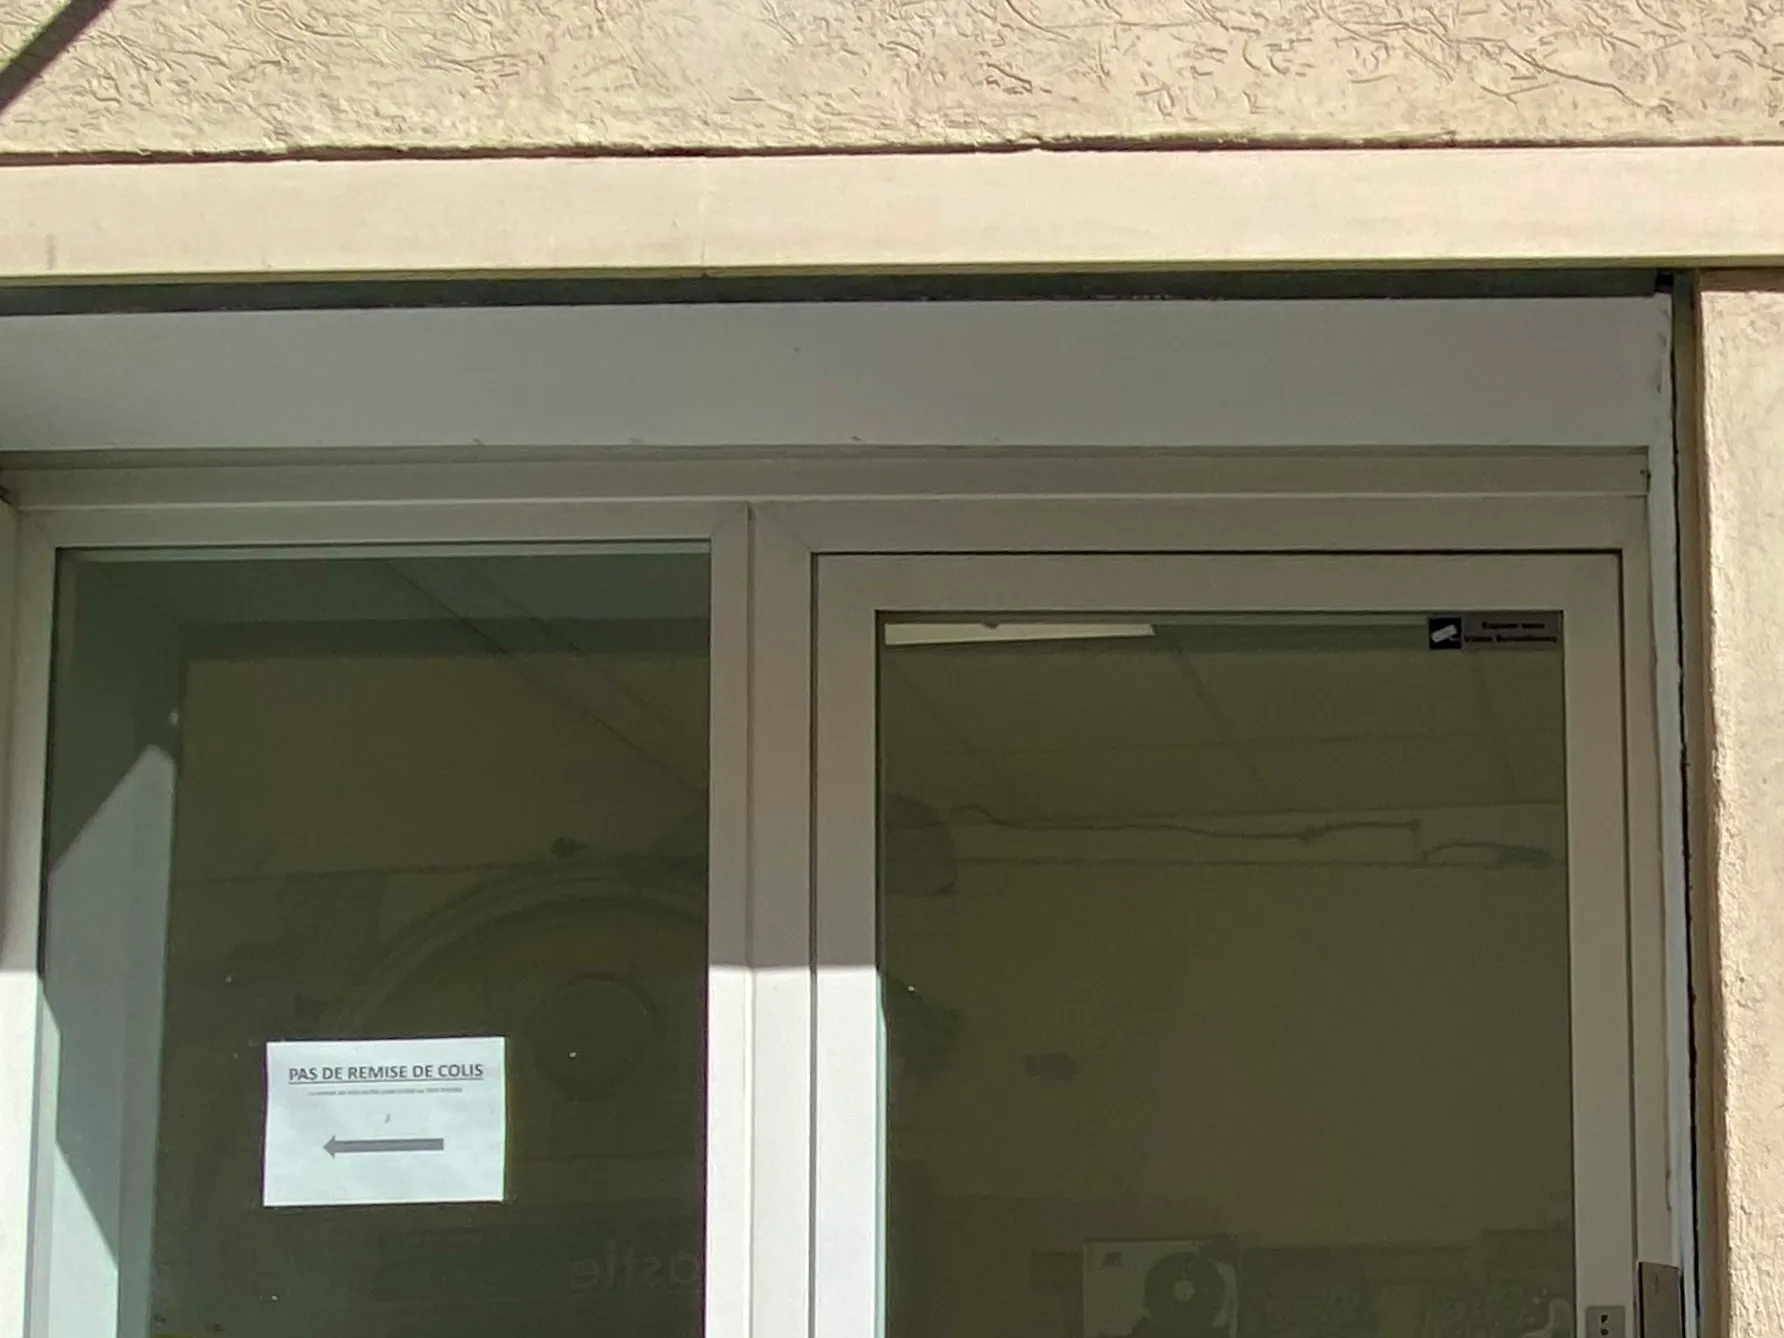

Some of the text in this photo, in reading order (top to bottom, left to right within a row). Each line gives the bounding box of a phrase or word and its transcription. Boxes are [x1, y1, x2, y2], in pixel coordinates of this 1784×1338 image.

[288, 1063, 483, 1081] PAS DE REMISE DE COLIS
